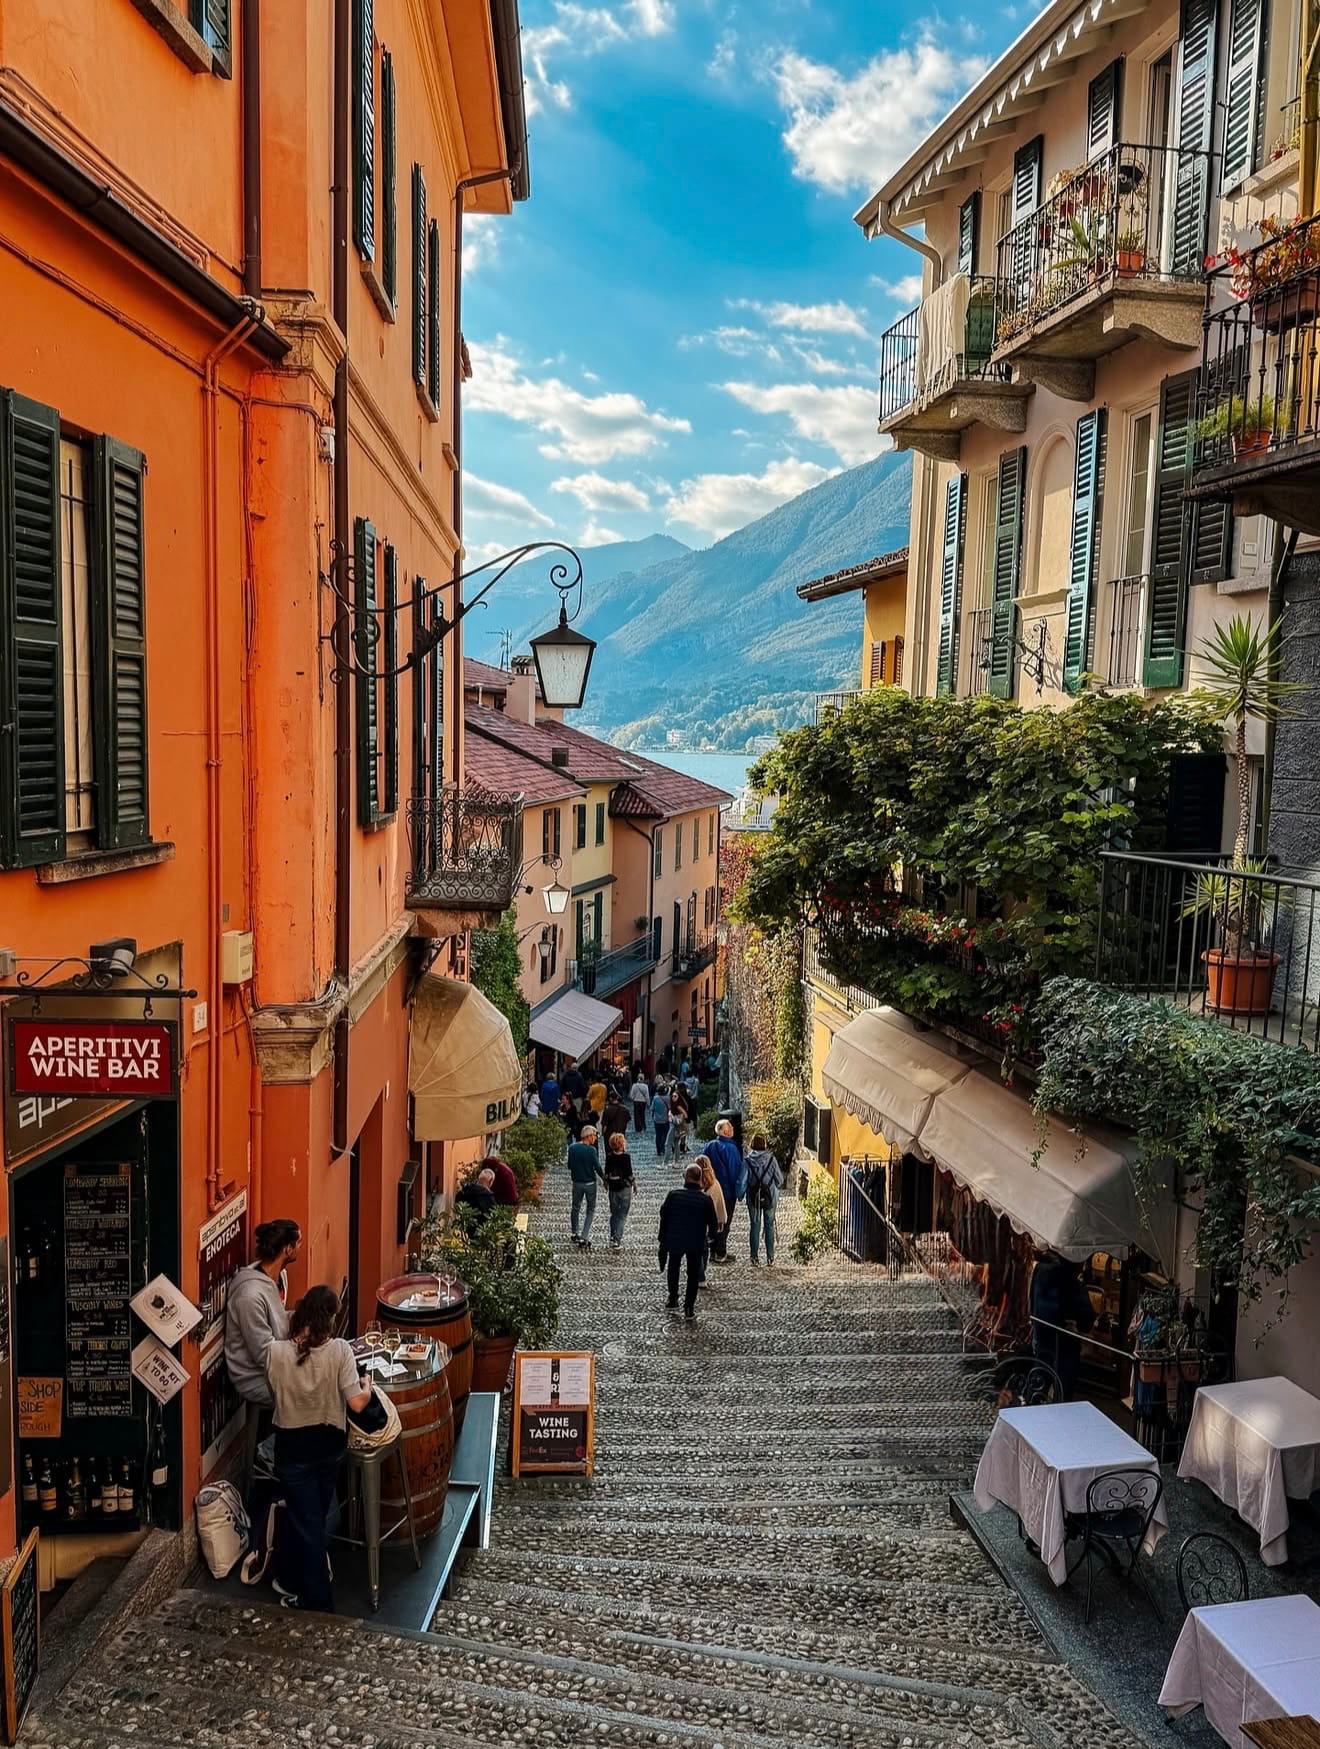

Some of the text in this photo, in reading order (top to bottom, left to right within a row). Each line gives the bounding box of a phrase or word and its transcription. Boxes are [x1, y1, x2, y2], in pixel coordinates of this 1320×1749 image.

[27, 1036, 161, 1058] APERITIVI
[30, 1057, 160, 1079] WINE BAR
[206, 1220, 241, 1263] ENOTECA
[151, 1366, 170, 1386] TO GO
[152, 1354, 180, 1384] WINE KIT
[28, 1380, 61, 1399] SHOP
[539, 1417, 569, 1427] WINE
[529, 1428, 578, 1439] TASTING
